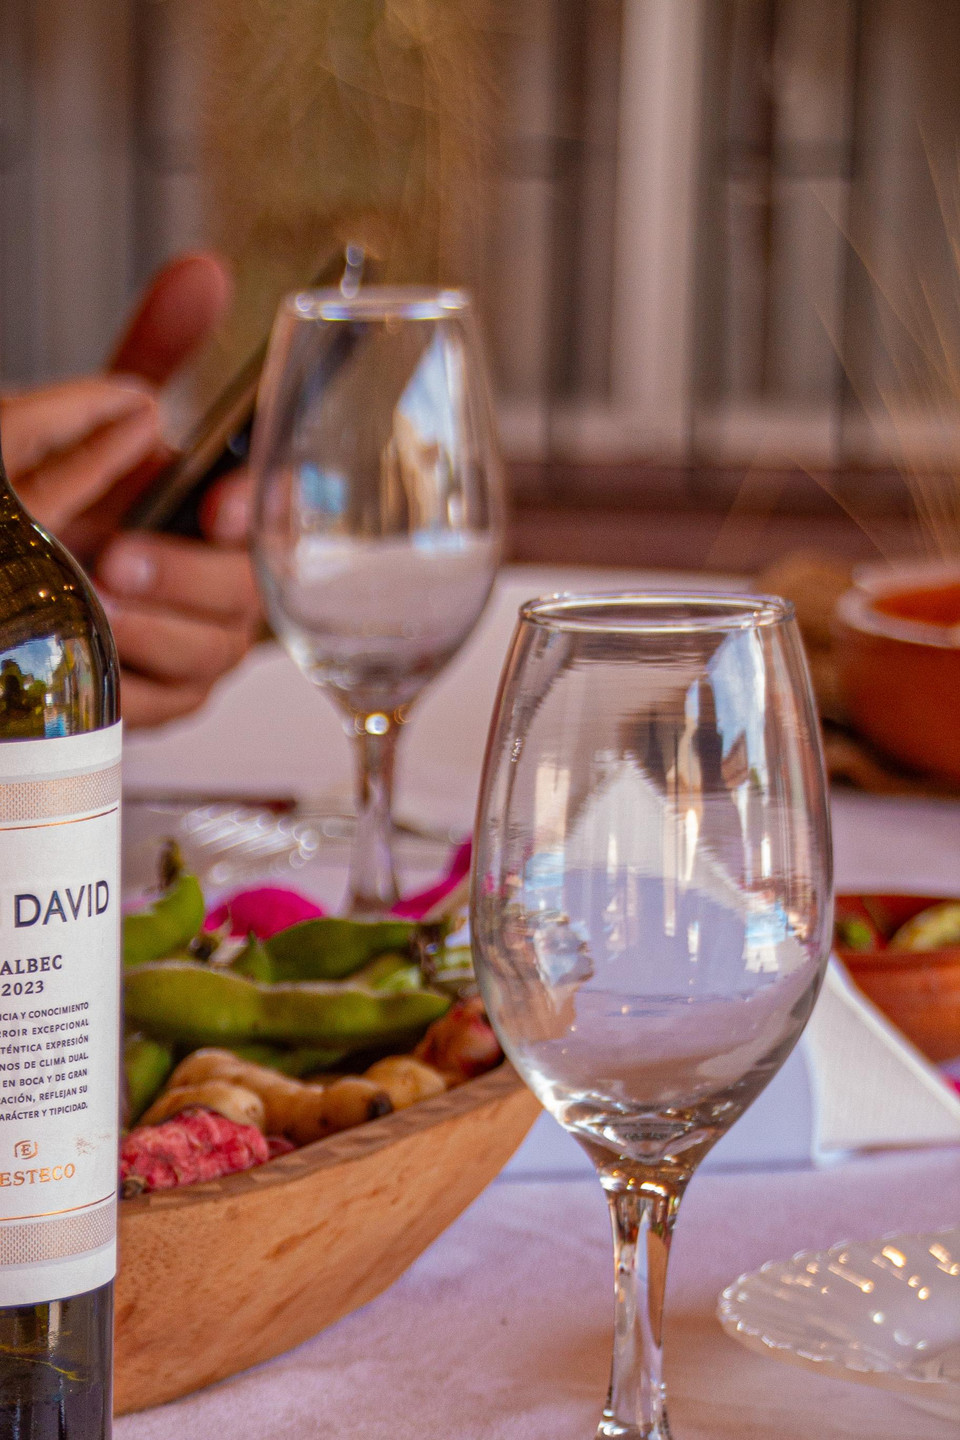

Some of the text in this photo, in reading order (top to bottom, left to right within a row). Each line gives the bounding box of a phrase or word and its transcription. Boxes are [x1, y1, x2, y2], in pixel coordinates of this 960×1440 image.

[14, 880, 109, 928] DAVID
[1, 980, 44, 997] 2023
[28, 1001, 89, 1019] CONOCIMIENTO
[32, 1018, 89, 1035] EXCEPCIONAL
[46, 1034, 89, 1050] EXPRESIÓN
[24, 1060, 36, 1069] DE
[39, 1056, 66, 1067] CLIMA
[2, 1079, 16, 1088] EN
[19, 1077, 44, 1087] BOCA
[46, 1075, 52, 1083] Y
[55, 1073, 66, 1082] DE
[68, 1068, 88, 1080] GRAN
[39, 1088, 77, 1101] REFLEJAN
[79, 1085, 88, 1094] SU
[41, 1109, 47, 1117] Y
[49, 1101, 88, 1116] TIPICIDAD.
